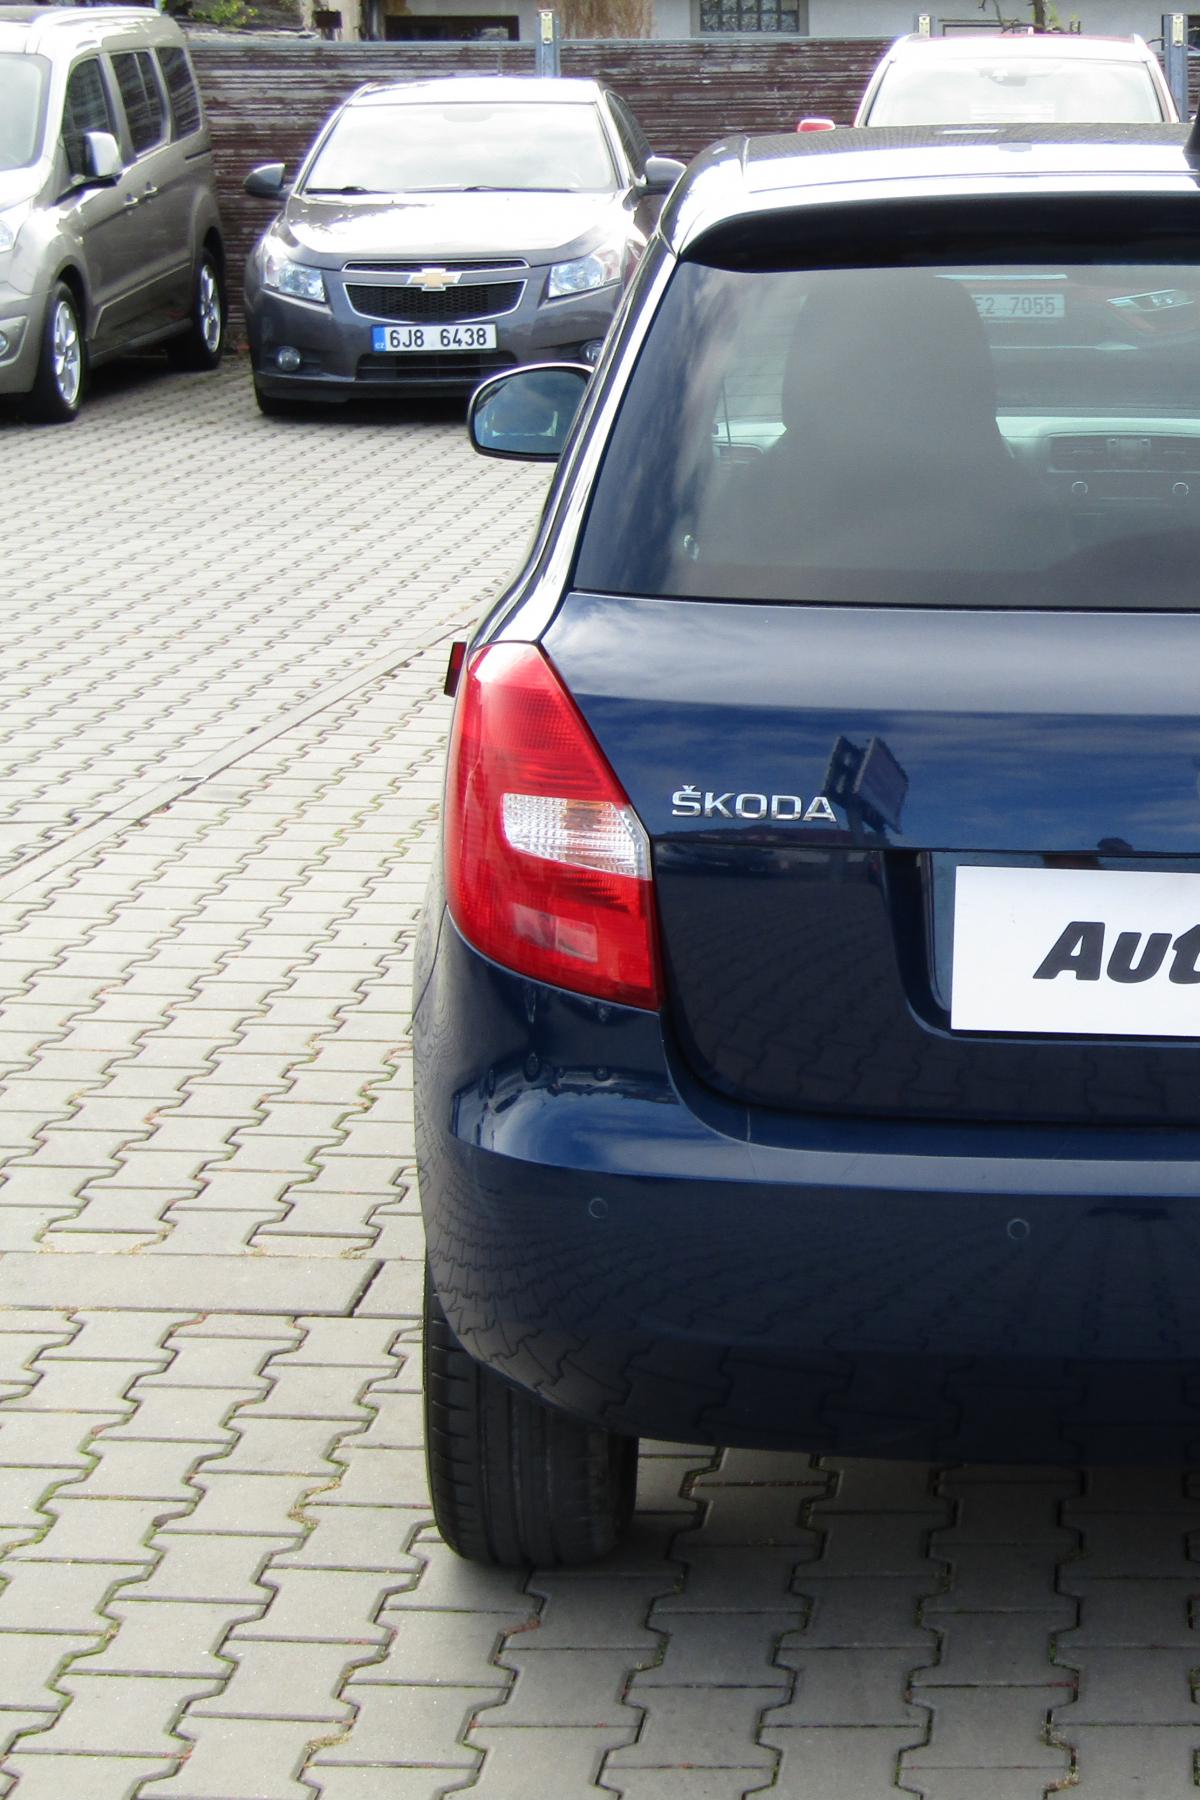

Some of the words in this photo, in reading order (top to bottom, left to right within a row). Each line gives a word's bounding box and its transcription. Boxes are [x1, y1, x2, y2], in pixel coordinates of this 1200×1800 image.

[1009, 296, 1055, 315] 7055
[389, 329, 425, 348] 6J8
[440, 327, 487, 347] 6438
[671, 785, 837, 822] ŠKODA
